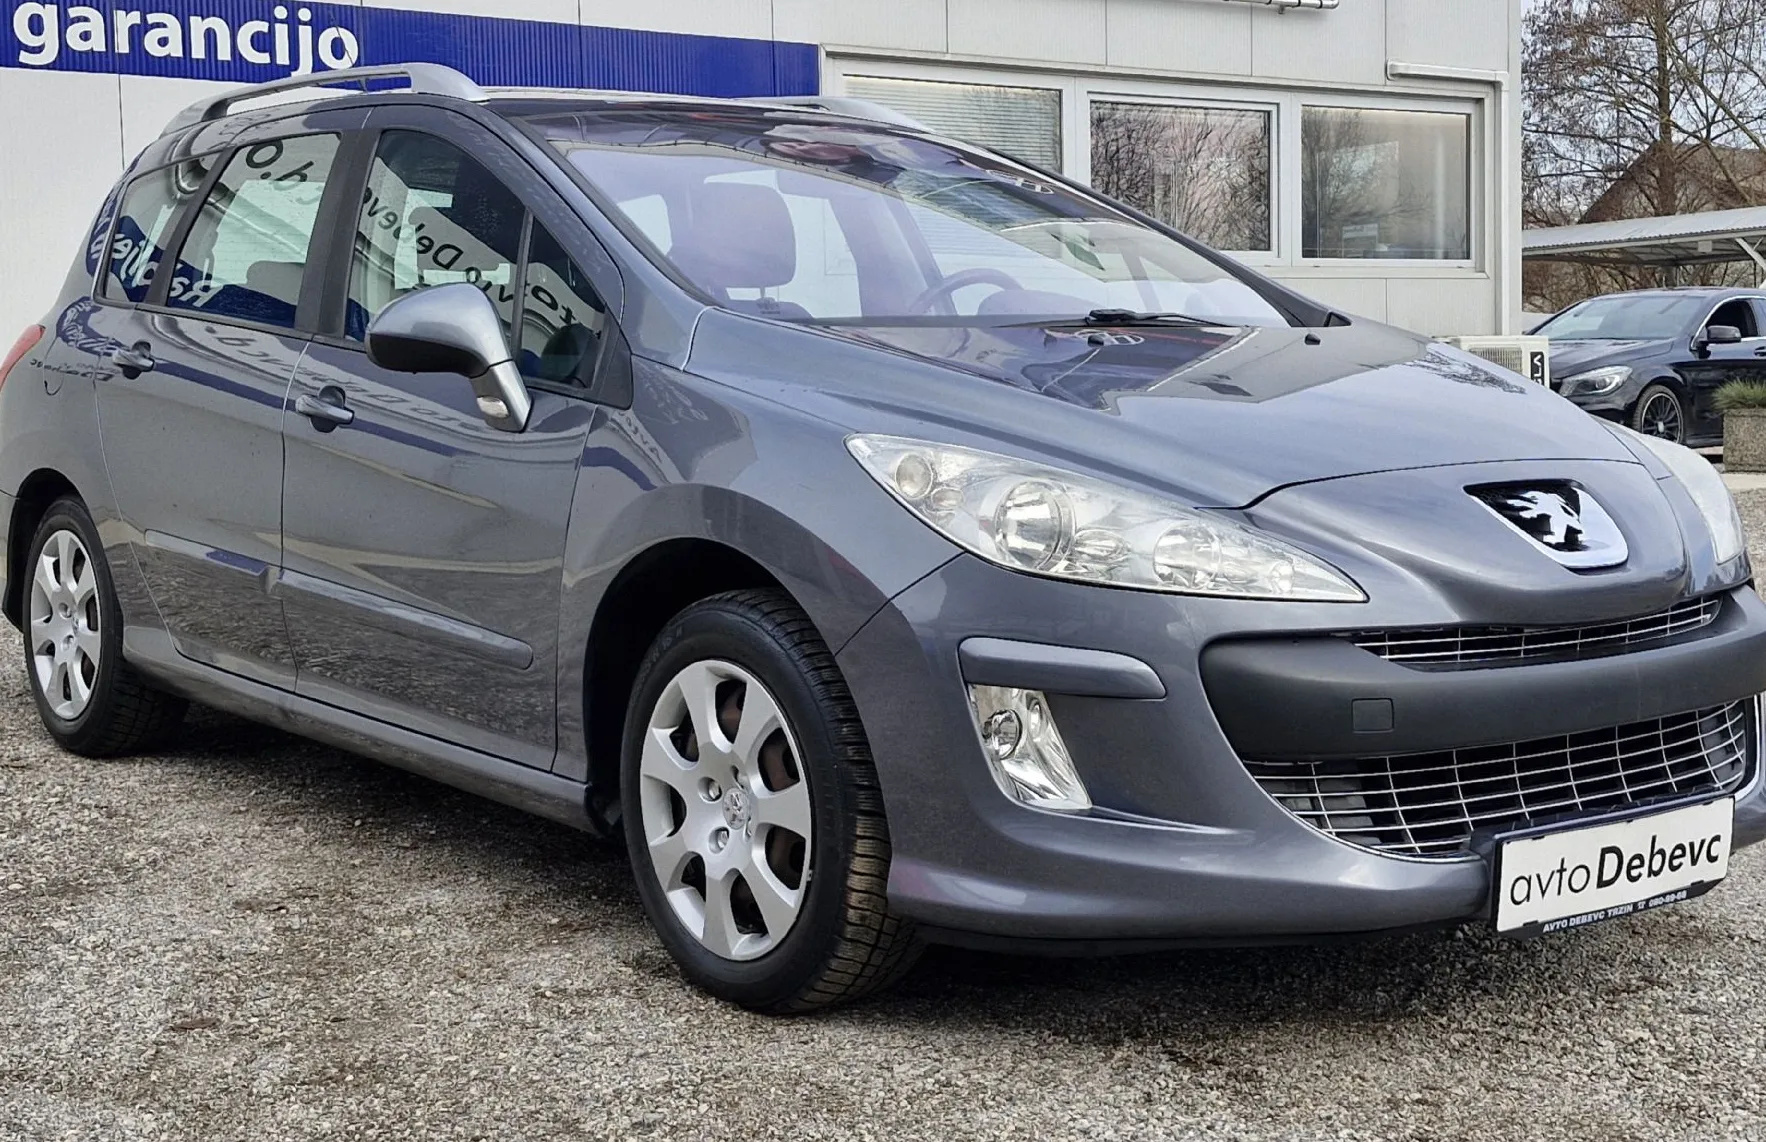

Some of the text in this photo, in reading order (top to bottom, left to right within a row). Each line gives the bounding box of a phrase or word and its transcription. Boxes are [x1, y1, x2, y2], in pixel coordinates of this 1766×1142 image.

[12, 0, 359, 77] garancijo
[1510, 835, 1722, 906] avto Debevc
[1542, 919, 1568, 933] AVTO
[1569, 911, 1605, 927] DEBEVC
[1607, 902, 1634, 918] TRZIN
